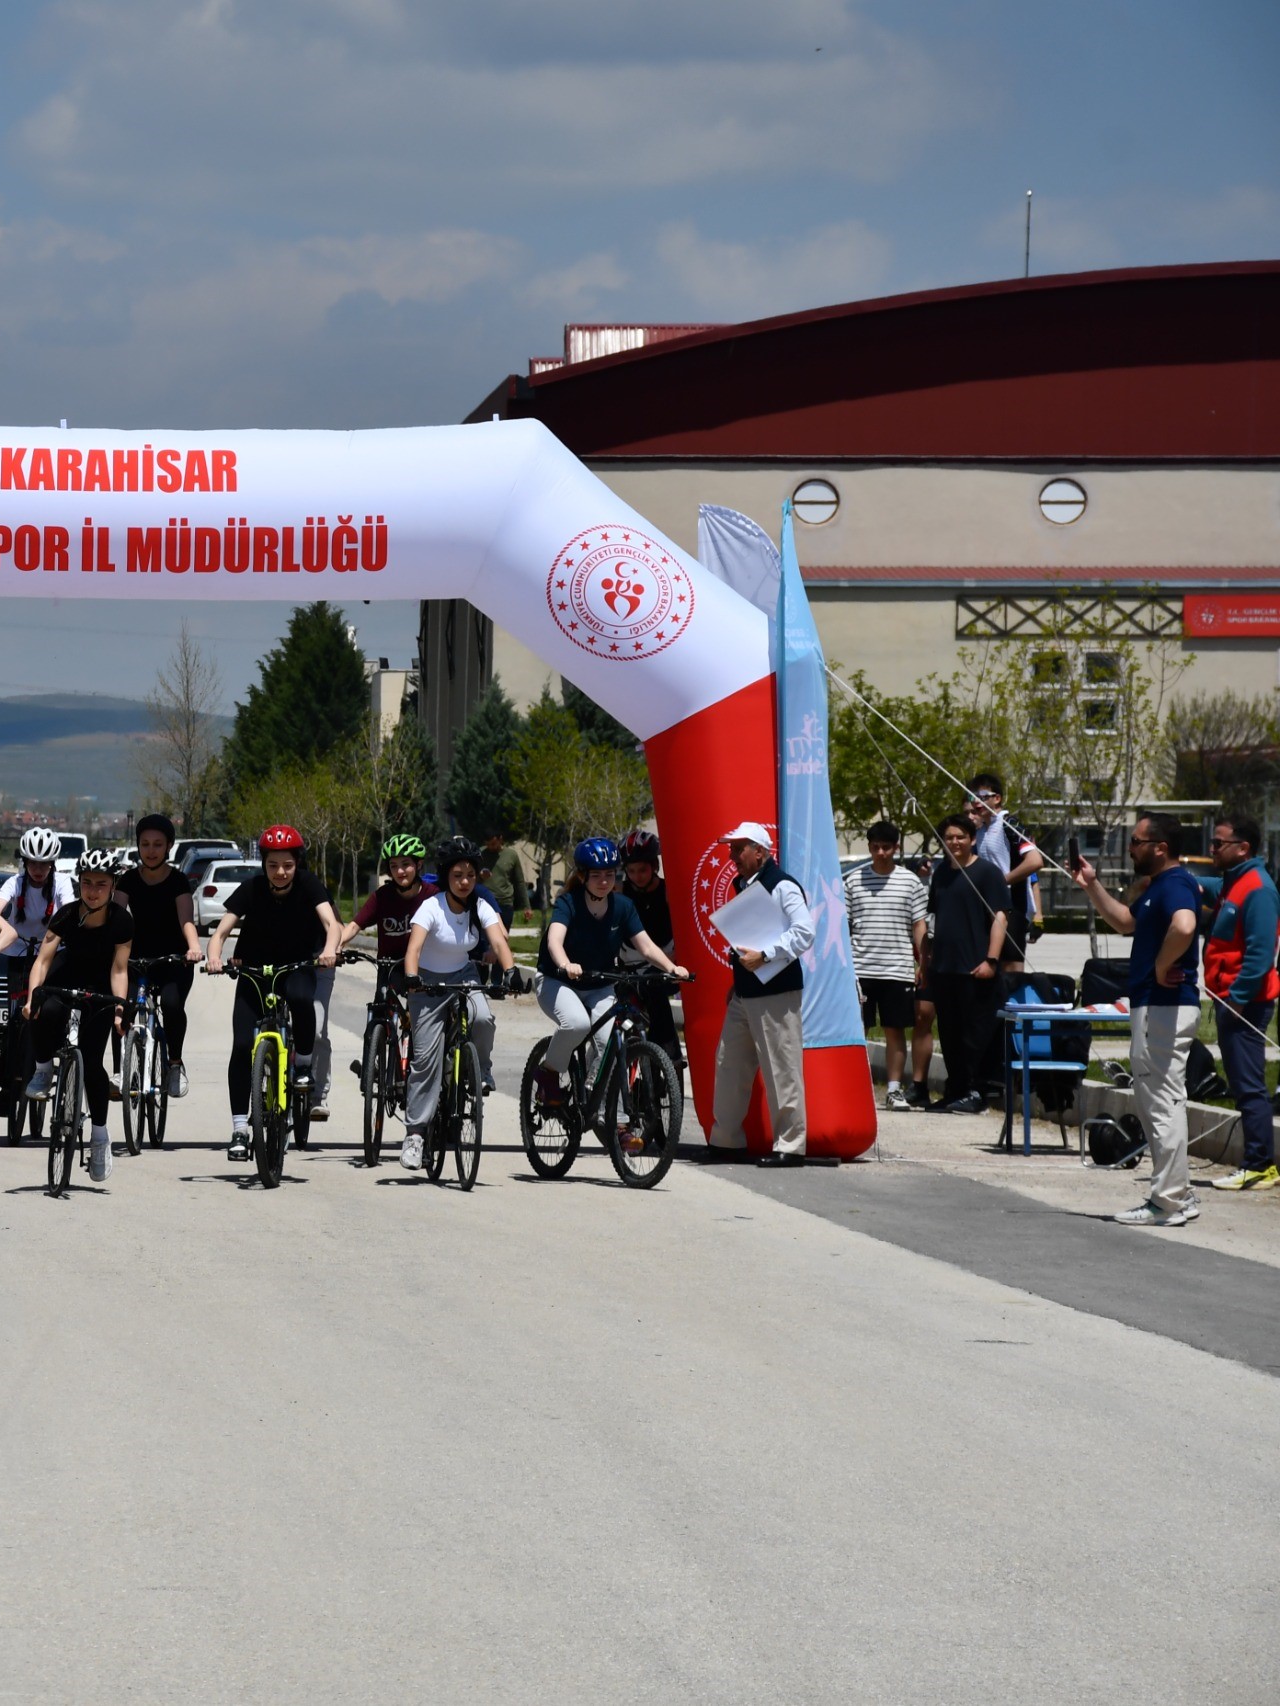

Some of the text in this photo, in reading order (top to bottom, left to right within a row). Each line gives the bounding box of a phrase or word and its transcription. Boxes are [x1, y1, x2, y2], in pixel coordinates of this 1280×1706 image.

[82, 518, 115, 571] İL
[128, 516, 387, 573] MÜDÜRLÜĞÜ
[574, 547, 669, 635] TÜRKİYE CUMHURİYETİ GENÇLİK VE SPOR BAKANLIĞI
[716, 863, 738, 907] MHURİYE
